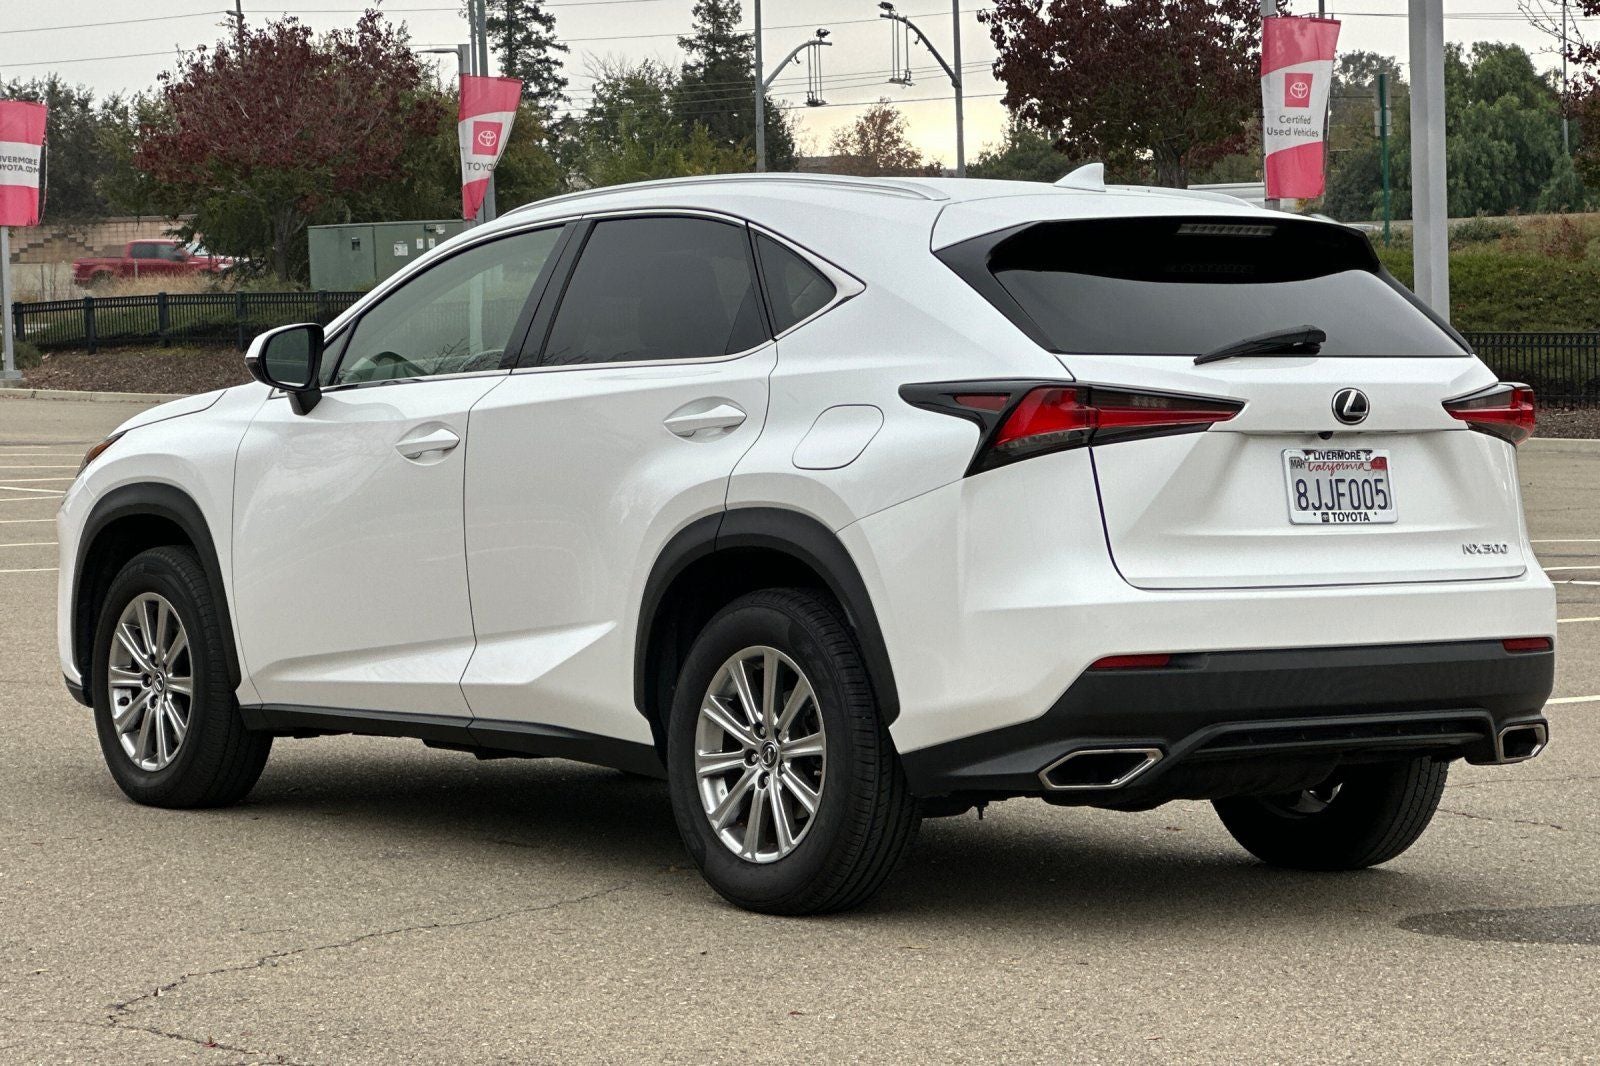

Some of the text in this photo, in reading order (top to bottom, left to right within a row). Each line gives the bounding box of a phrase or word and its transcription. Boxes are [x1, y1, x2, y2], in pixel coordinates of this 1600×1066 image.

[1278, 115, 1311, 125] Certified
[1266, 127, 1319, 137] Used Vehicles
[1313, 450, 1361, 461] LIVERMORE
[1307, 460, 1365, 477] California
[1295, 478, 1388, 511] 8JJF005
[1331, 511, 1370, 522] TOYOTA
